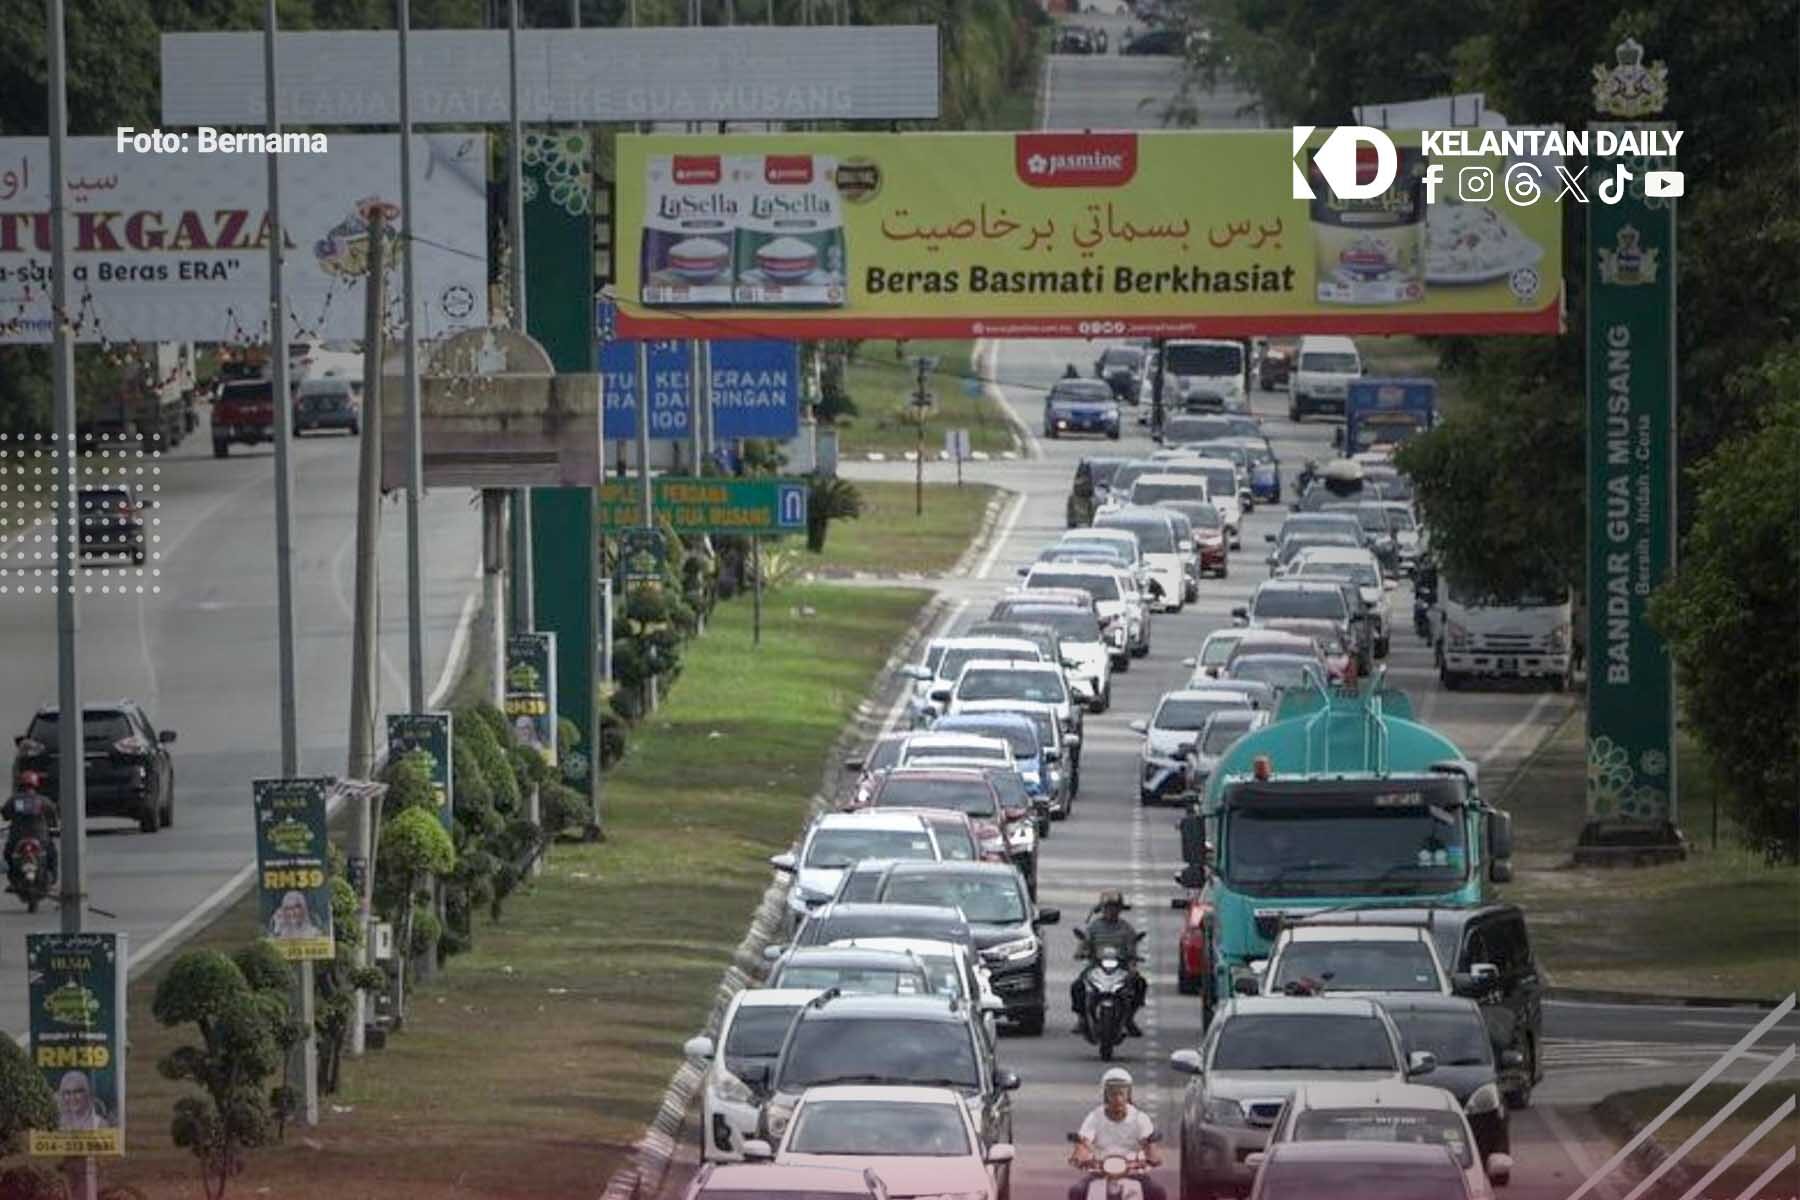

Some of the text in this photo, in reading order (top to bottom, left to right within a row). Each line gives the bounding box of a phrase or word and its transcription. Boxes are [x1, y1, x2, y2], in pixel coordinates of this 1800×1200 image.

[1208, 212, 1283, 249] برس
[99, 261, 168, 281] Beras
[866, 264, 1296, 295] Beras Basmati Berkhasiat
[1607, 324, 1631, 685] BANDAR GUA MUSANG
[263, 869, 325, 889] RM39
[37, 1045, 110, 1068] RM39
